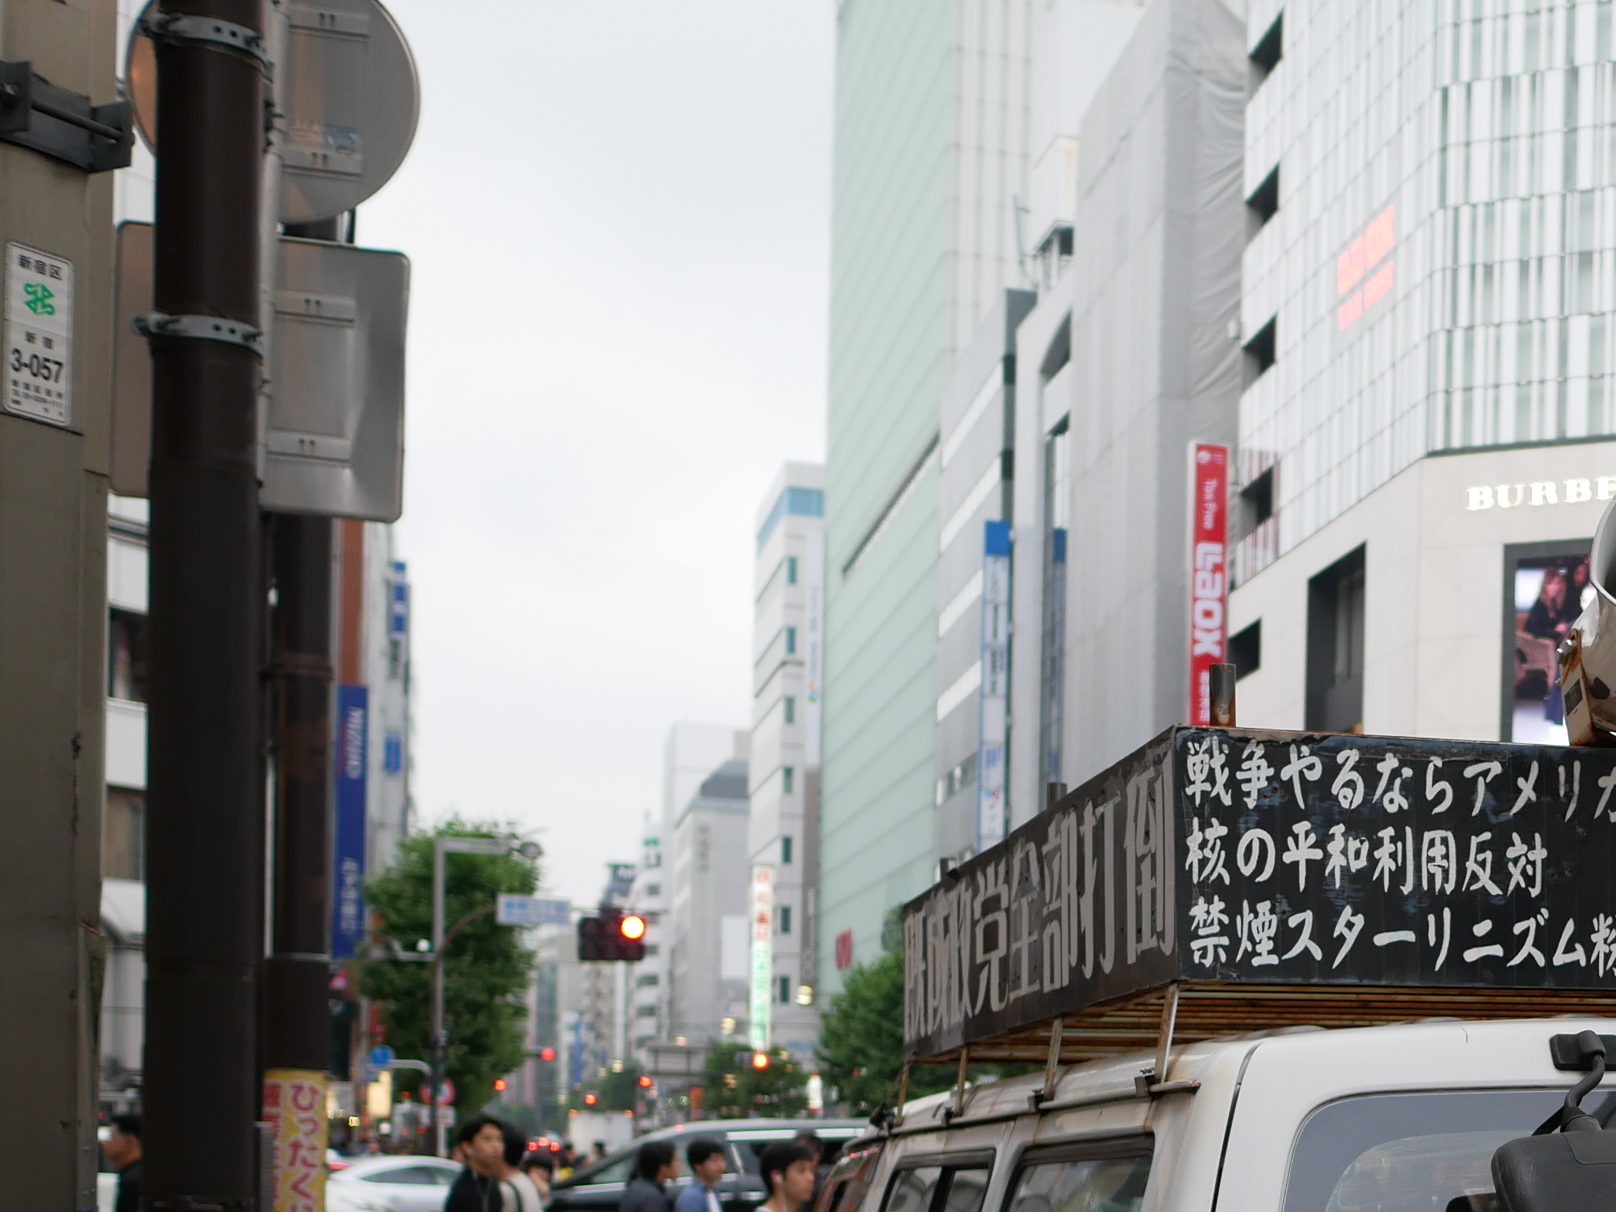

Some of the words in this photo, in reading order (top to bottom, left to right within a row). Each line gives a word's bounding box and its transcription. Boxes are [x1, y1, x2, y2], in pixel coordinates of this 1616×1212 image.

[18, 254, 63, 281] 新宿区
[11, 347, 64, 384] 3-057
[1185, 817, 1548, 898] 核の平和利用反対
